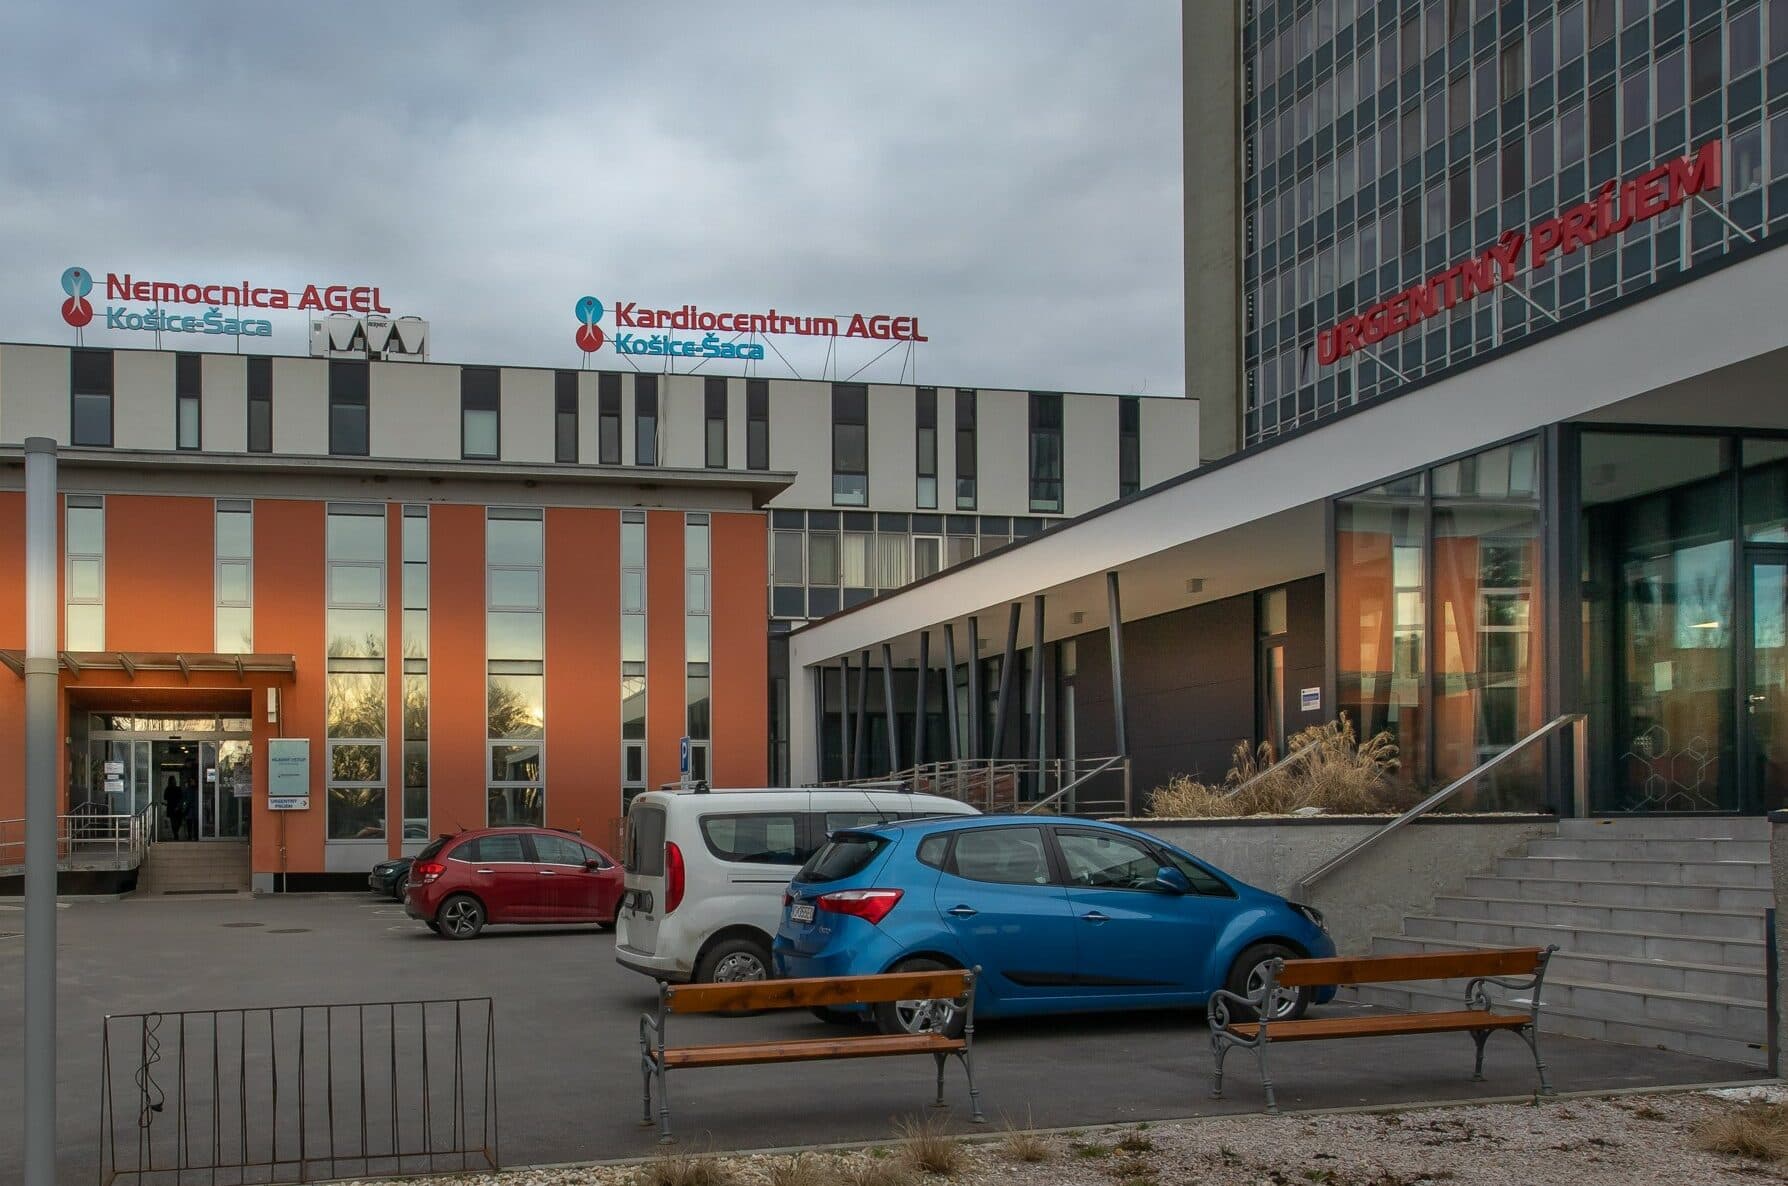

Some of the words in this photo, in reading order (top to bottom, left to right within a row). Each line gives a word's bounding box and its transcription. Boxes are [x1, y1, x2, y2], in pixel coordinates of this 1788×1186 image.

[1317, 229, 1526, 367] URGENTNÝ
[1531, 139, 1722, 268] PRÍJEM
[107, 273, 289, 309] Nemocnica
[298, 284, 391, 314] AGEL
[107, 306, 273, 337] Košice-Šaca
[615, 302, 838, 336] Kardiocentrum
[846, 313, 929, 341] AGEL
[615, 332, 765, 361] Košice-Šaca
[682, 742, 687, 769] P
